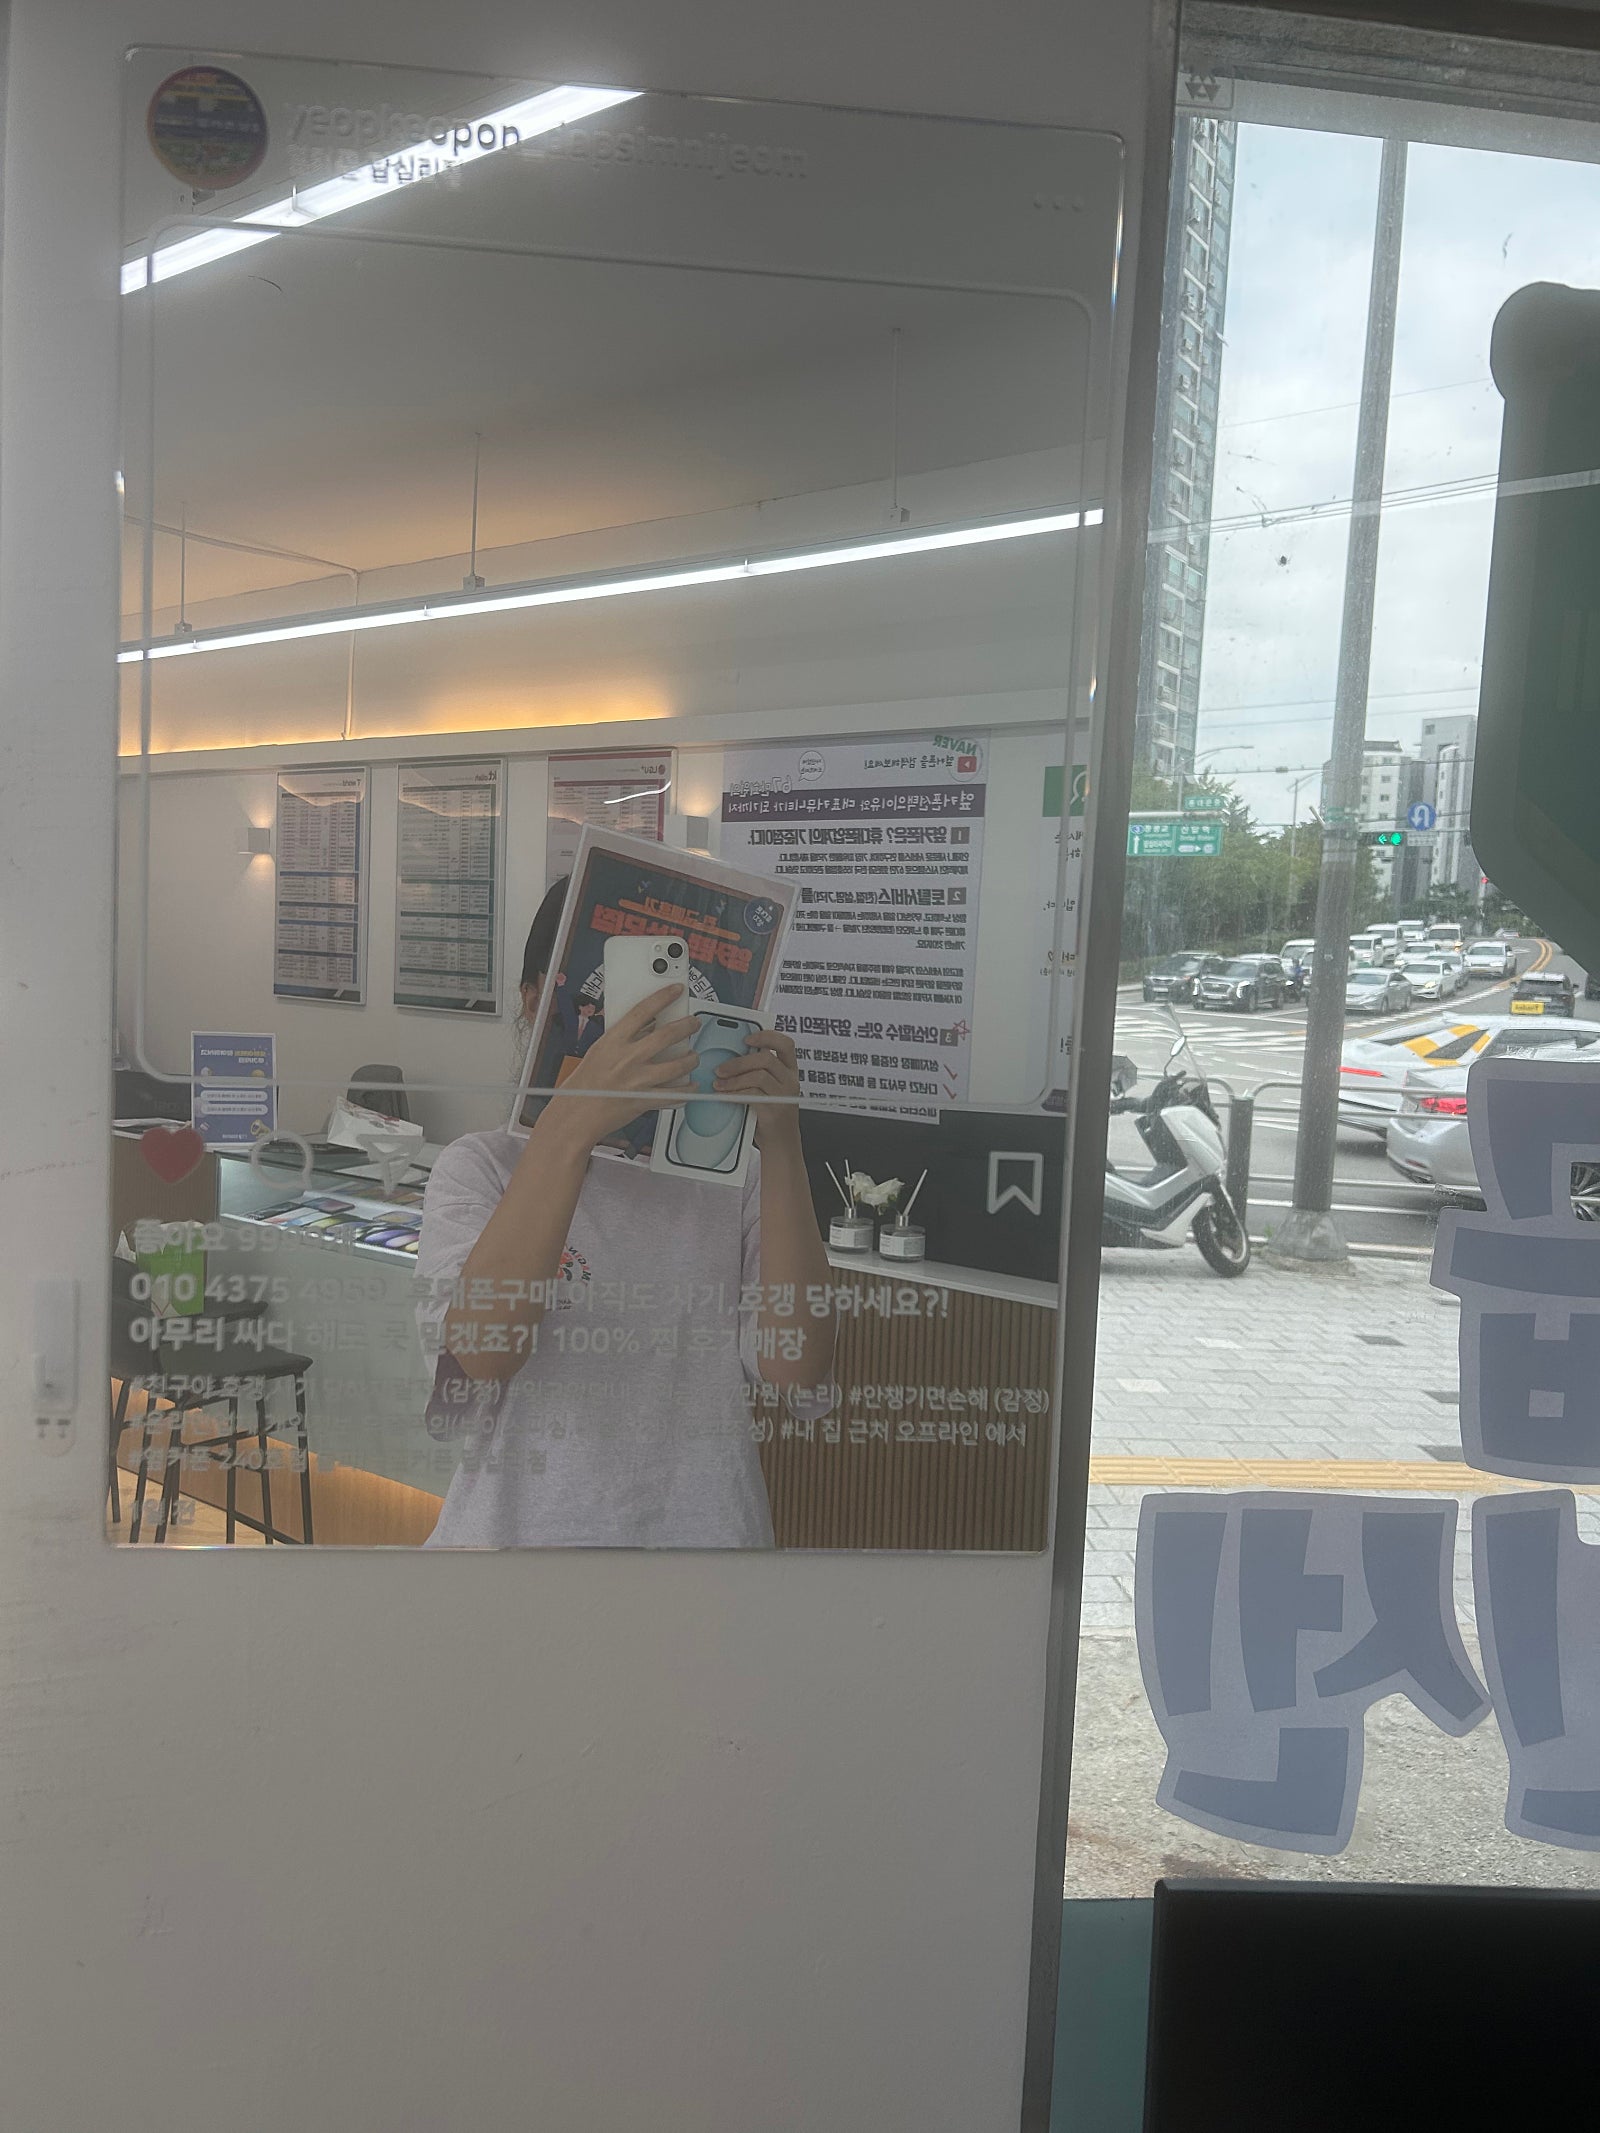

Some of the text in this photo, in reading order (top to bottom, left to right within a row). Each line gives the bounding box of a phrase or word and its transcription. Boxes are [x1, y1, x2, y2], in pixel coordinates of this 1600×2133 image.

[133, 1219, 229, 1254] 좋아요
[130, 1272, 196, 1302] 010
[204, 1274, 289, 1304] 4375
[560, 1278, 659, 1312] 아직도
[804, 1285, 950, 1319] 당하세요?!
[130, 1316, 225, 1352] 아무리
[233, 1316, 296, 1352] 싸다
[303, 1319, 369, 1353] 해도
[377, 1320, 411, 1353] 못
[416, 1321, 540, 1355] 믿겠죠?!
[553, 1326, 640, 1354] 100%
[650, 1325, 679, 1358] 찐
[130, 1374, 213, 1400] #친구야
[441, 1377, 502, 1405] (감정)
[786, 1382, 843, 1409] (논리)
[848, 1385, 990, 1413] #안챙기면손해
[993, 1386, 1051, 1415] (감정)
[780, 1419, 815, 1444] #내
[822, 1420, 842, 1445] 집
[847, 1420, 890, 1444] 근처
[895, 1421, 979, 1447] 오프라인
[984, 1422, 1028, 1448] 에서
